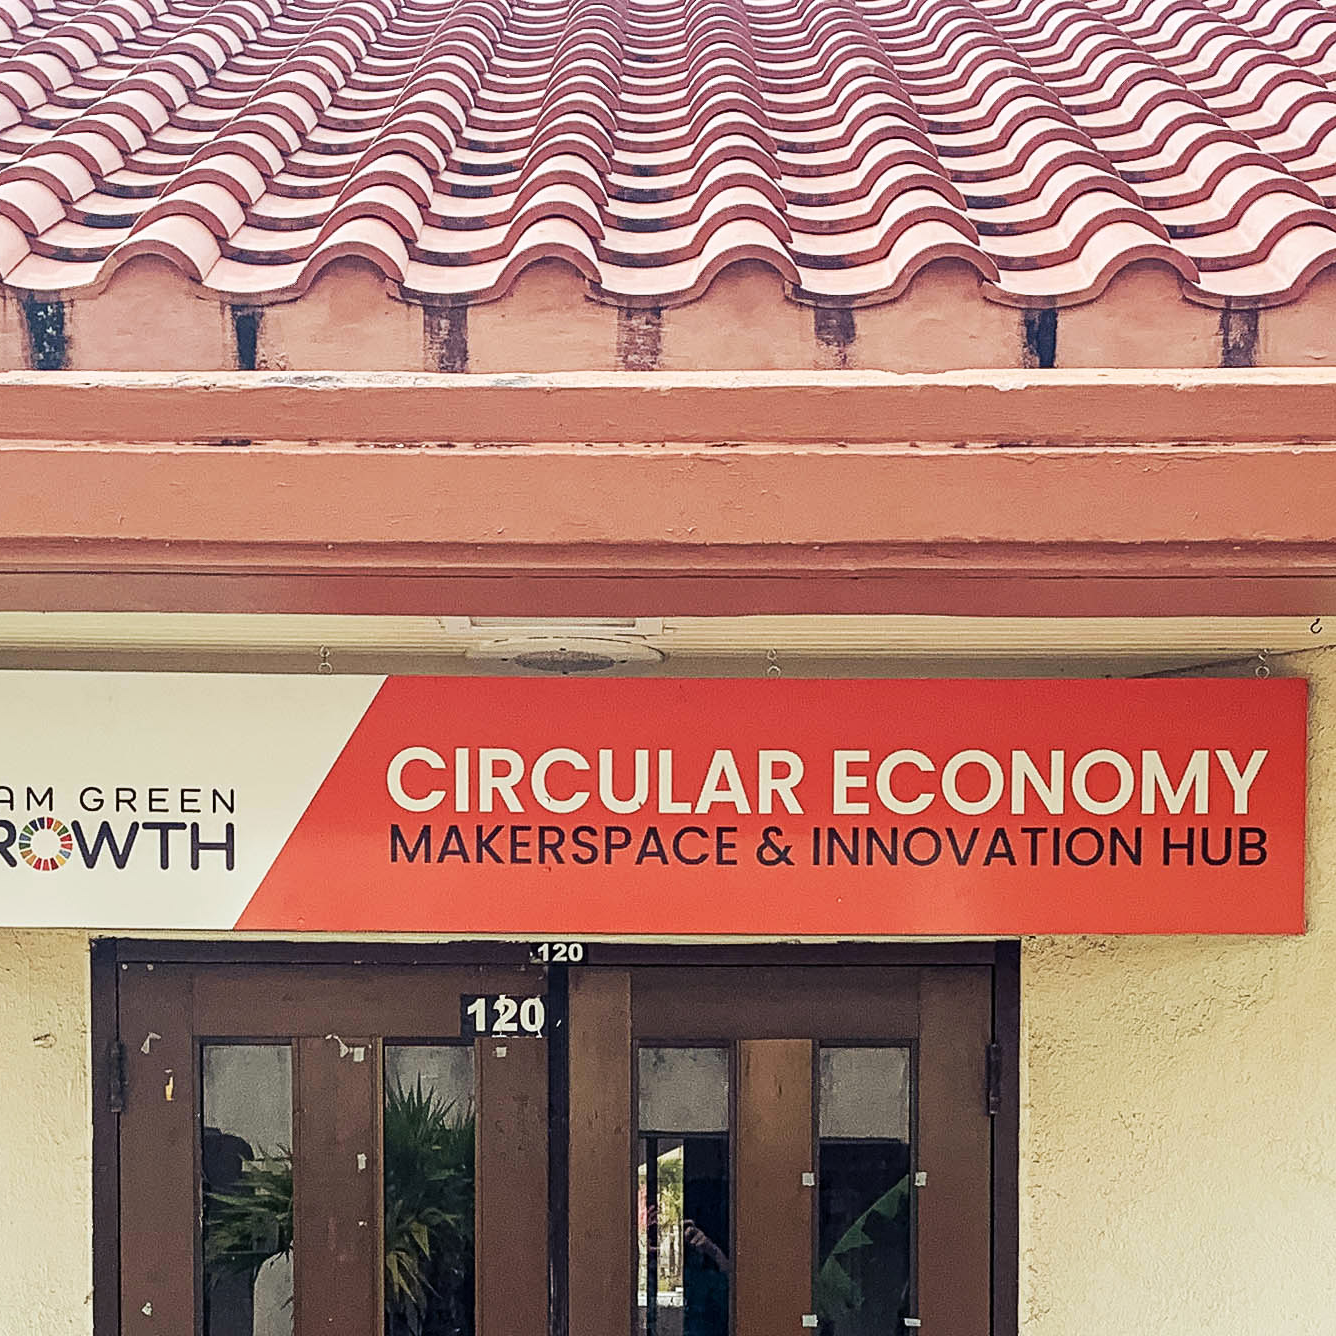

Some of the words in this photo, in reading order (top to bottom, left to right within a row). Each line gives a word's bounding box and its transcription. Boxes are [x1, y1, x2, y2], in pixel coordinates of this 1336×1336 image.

[79, 787, 235, 813] GREEN
[386, 746, 805, 816] CIRCULAR
[832, 748, 1270, 817] ECONOMY
[389, 824, 739, 867] MAKERSPACE
[756, 824, 795, 867] &
[811, 825, 1145, 868] INNOVATION
[1162, 826, 1269, 867] HUB
[537, 942, 584, 962] 120
[467, 996, 546, 1033] 120
